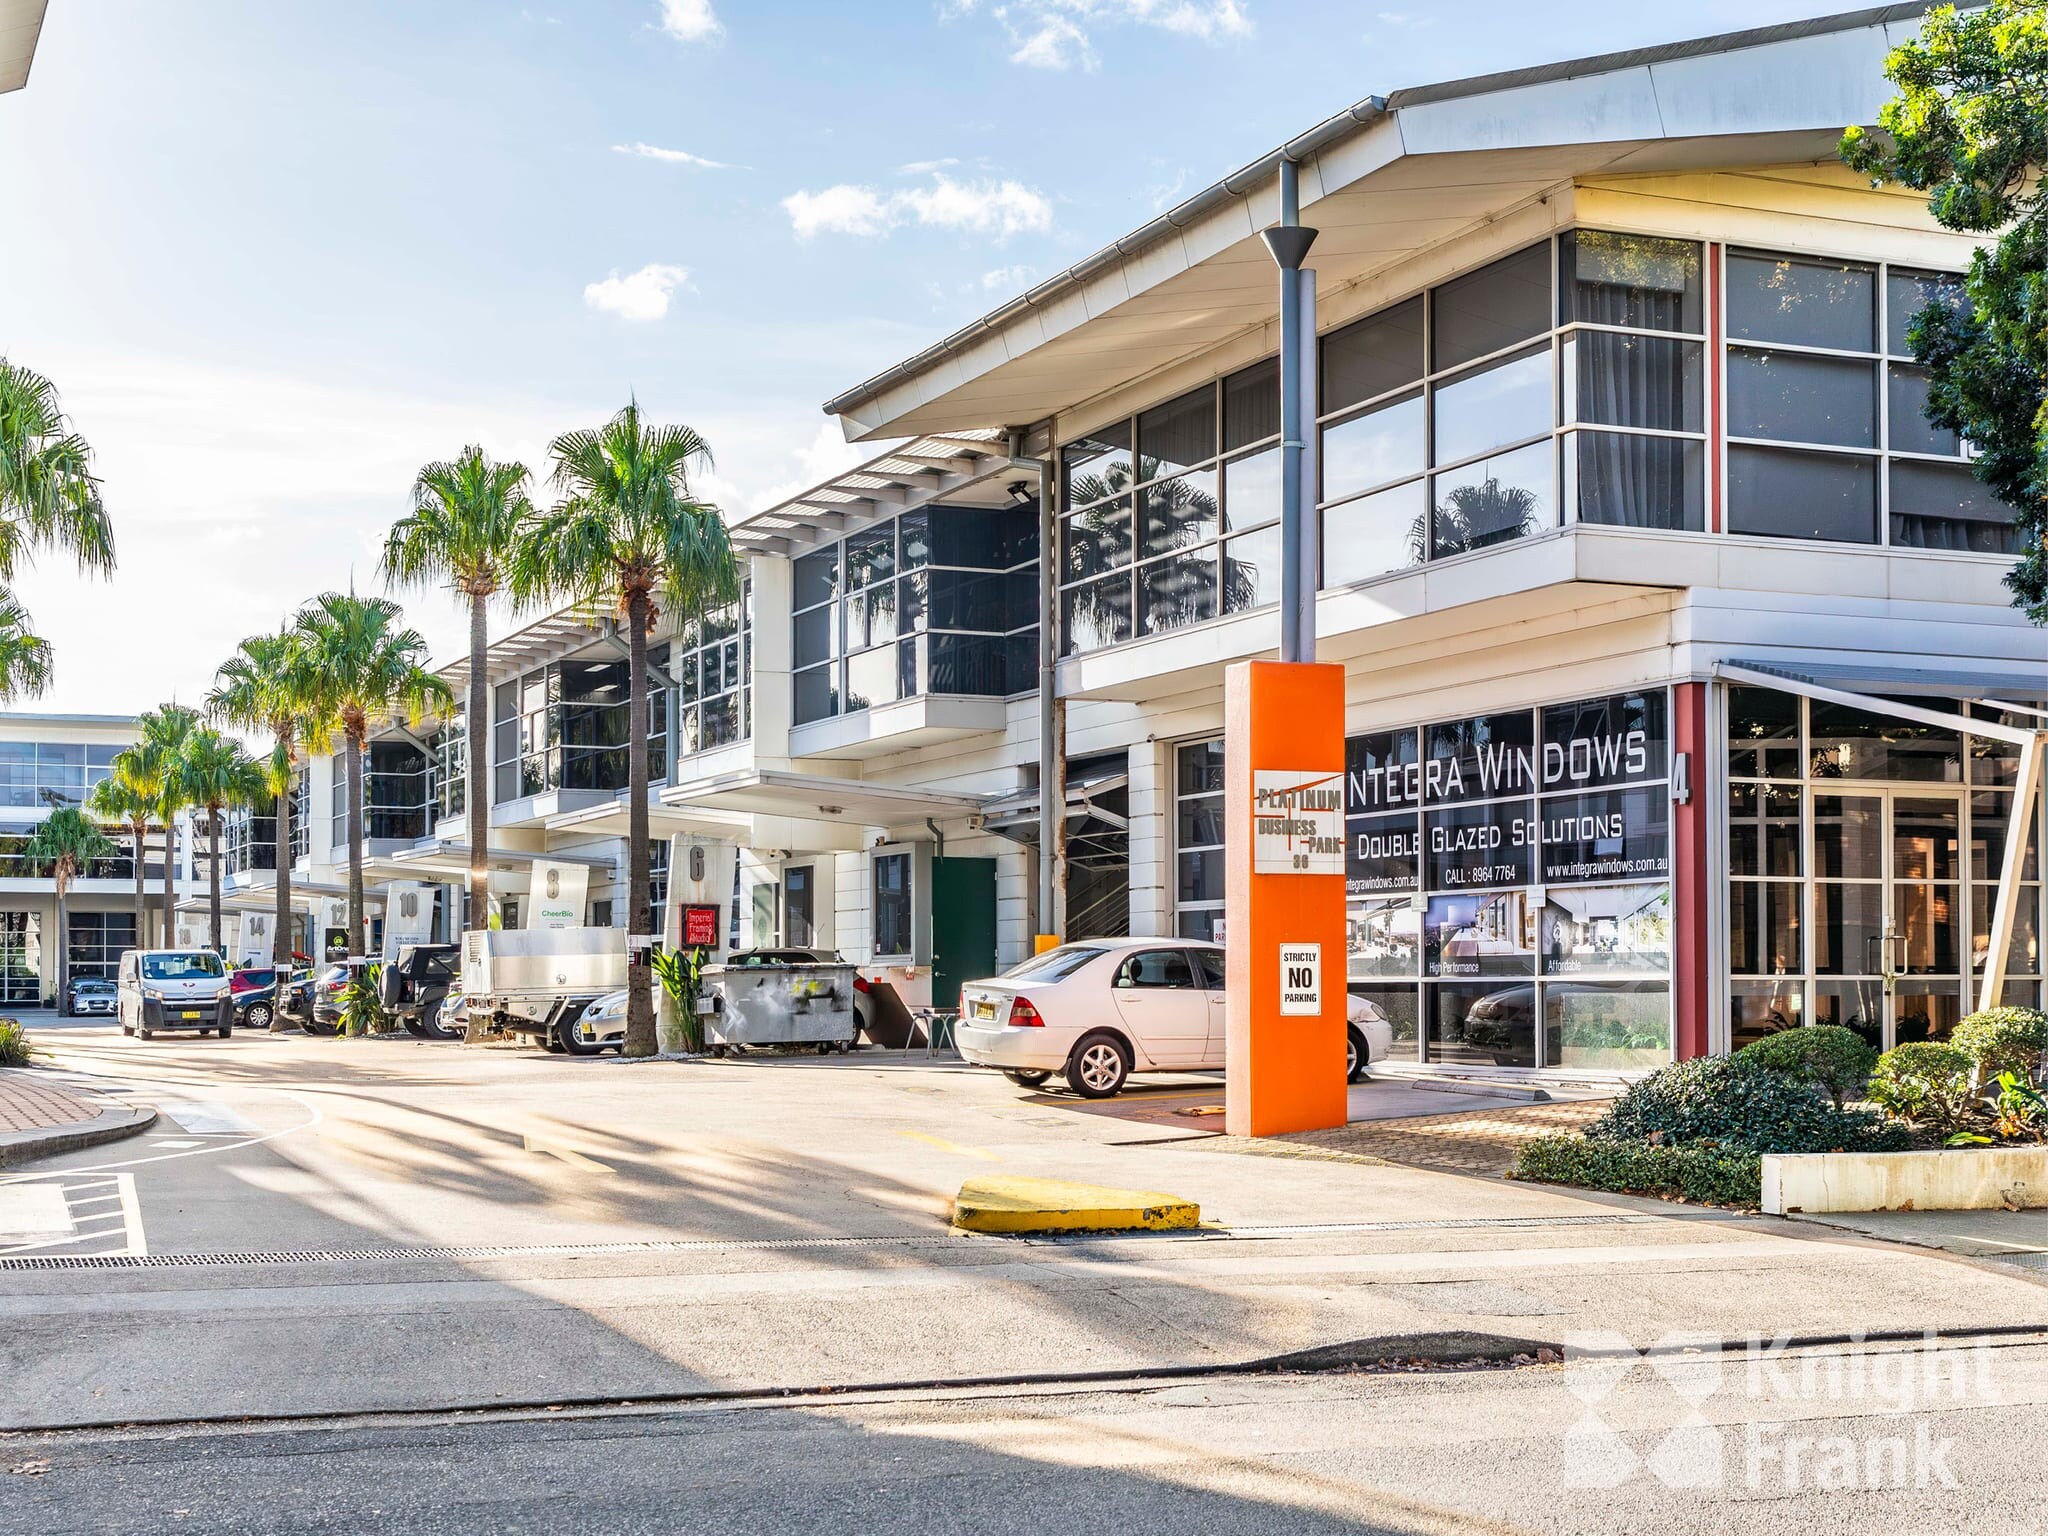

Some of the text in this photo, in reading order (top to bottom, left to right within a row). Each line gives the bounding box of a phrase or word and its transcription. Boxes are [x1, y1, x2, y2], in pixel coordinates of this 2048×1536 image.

[1350, 730, 1646, 808] NTEGRA WINDOWS
[1672, 752, 1691, 806] 4
[1258, 788, 1341, 809] PLATINUM
[1258, 819, 1317, 836] BUSINESS
[1358, 813, 1623, 860] DOUBLE GLAZED SOLUTIONS
[1309, 836, 1341, 854] PARK
[690, 846, 705, 881] 6
[1445, 868, 1466, 884] CALL
[1472, 866, 1493, 883] 8964
[1496, 864, 1516, 881] 7764
[1546, 857, 1668, 878] www.integrawindows.com.au
[547, 868, 559, 899] 8
[1346, 875, 1419, 893] ntegrawindows.com.au
[331, 903, 346, 926] 12
[400, 892, 418, 918] 10
[541, 910, 574, 918] CheerBio
[249, 917, 265, 937] 14
[1283, 952, 1317, 962] STRICTLY
[1288, 967, 1313, 988] NO
[1284, 993, 1317, 1003] PARKING
